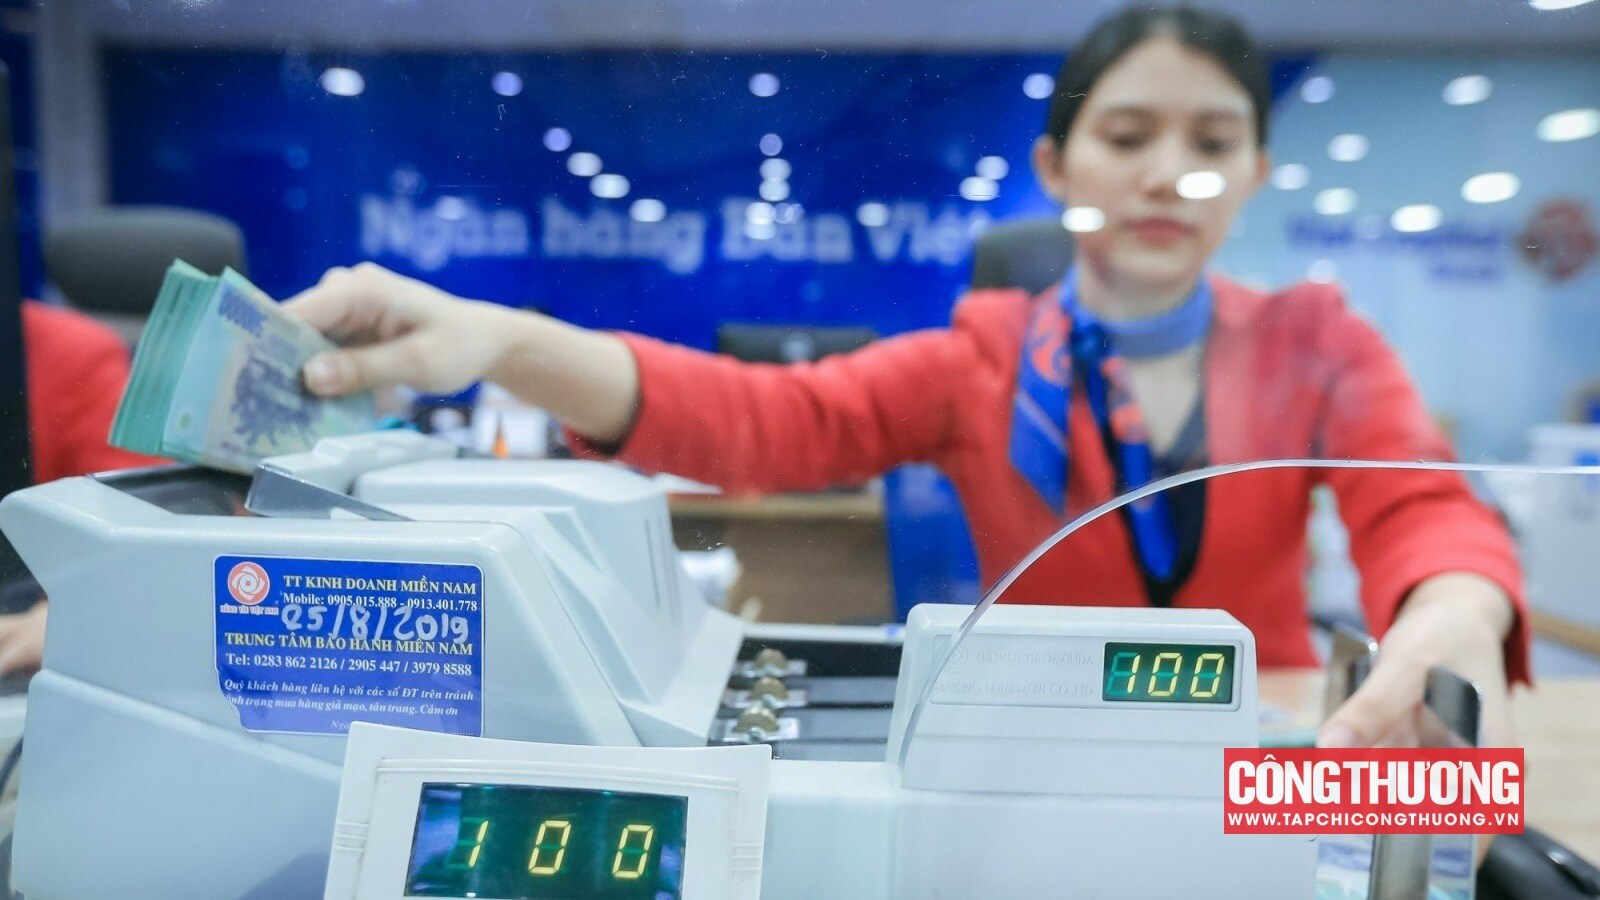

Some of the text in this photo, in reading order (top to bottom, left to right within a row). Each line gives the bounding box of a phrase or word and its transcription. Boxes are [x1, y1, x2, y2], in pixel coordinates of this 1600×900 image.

[283, 575, 476, 594] TT KINH DOANH MIỀN NAM
[283, 592, 324, 605] Mobile:
[327, 594, 397, 607] 0905.015.888
[407, 597, 478, 611] 0913.401.778
[224, 632, 275, 646] TRUNG
[278, 632, 312, 648] TÂM
[315, 632, 346, 650] BẢO
[439, 641, 473, 655] NAM
[226, 653, 251, 666] Tel:
[254, 655, 282, 667] 0283
[285, 656, 307, 668] 862
[309, 657, 338, 669] 2126
[348, 659, 376, 671] 2905
[379, 660, 401, 672] 447
[411, 661, 440, 674] 3979
[443, 663, 472, 675] 8588
[1127, 652, 1225, 698] 100
[247, 680, 279, 692] khách
[281, 682, 308, 694] hàng
[310, 683, 330, 694] liên
[333, 685, 346, 696] hệ
[349, 685, 364, 695] với
[366, 687, 385, 697] các
[387, 686, 401, 697] số
[402, 688, 419, 698] ĐT
[421, 690, 442, 699] trên
[445, 690, 474, 701] tránh
[275, 700, 297, 708] mua
[299, 699, 324, 710] hàng
